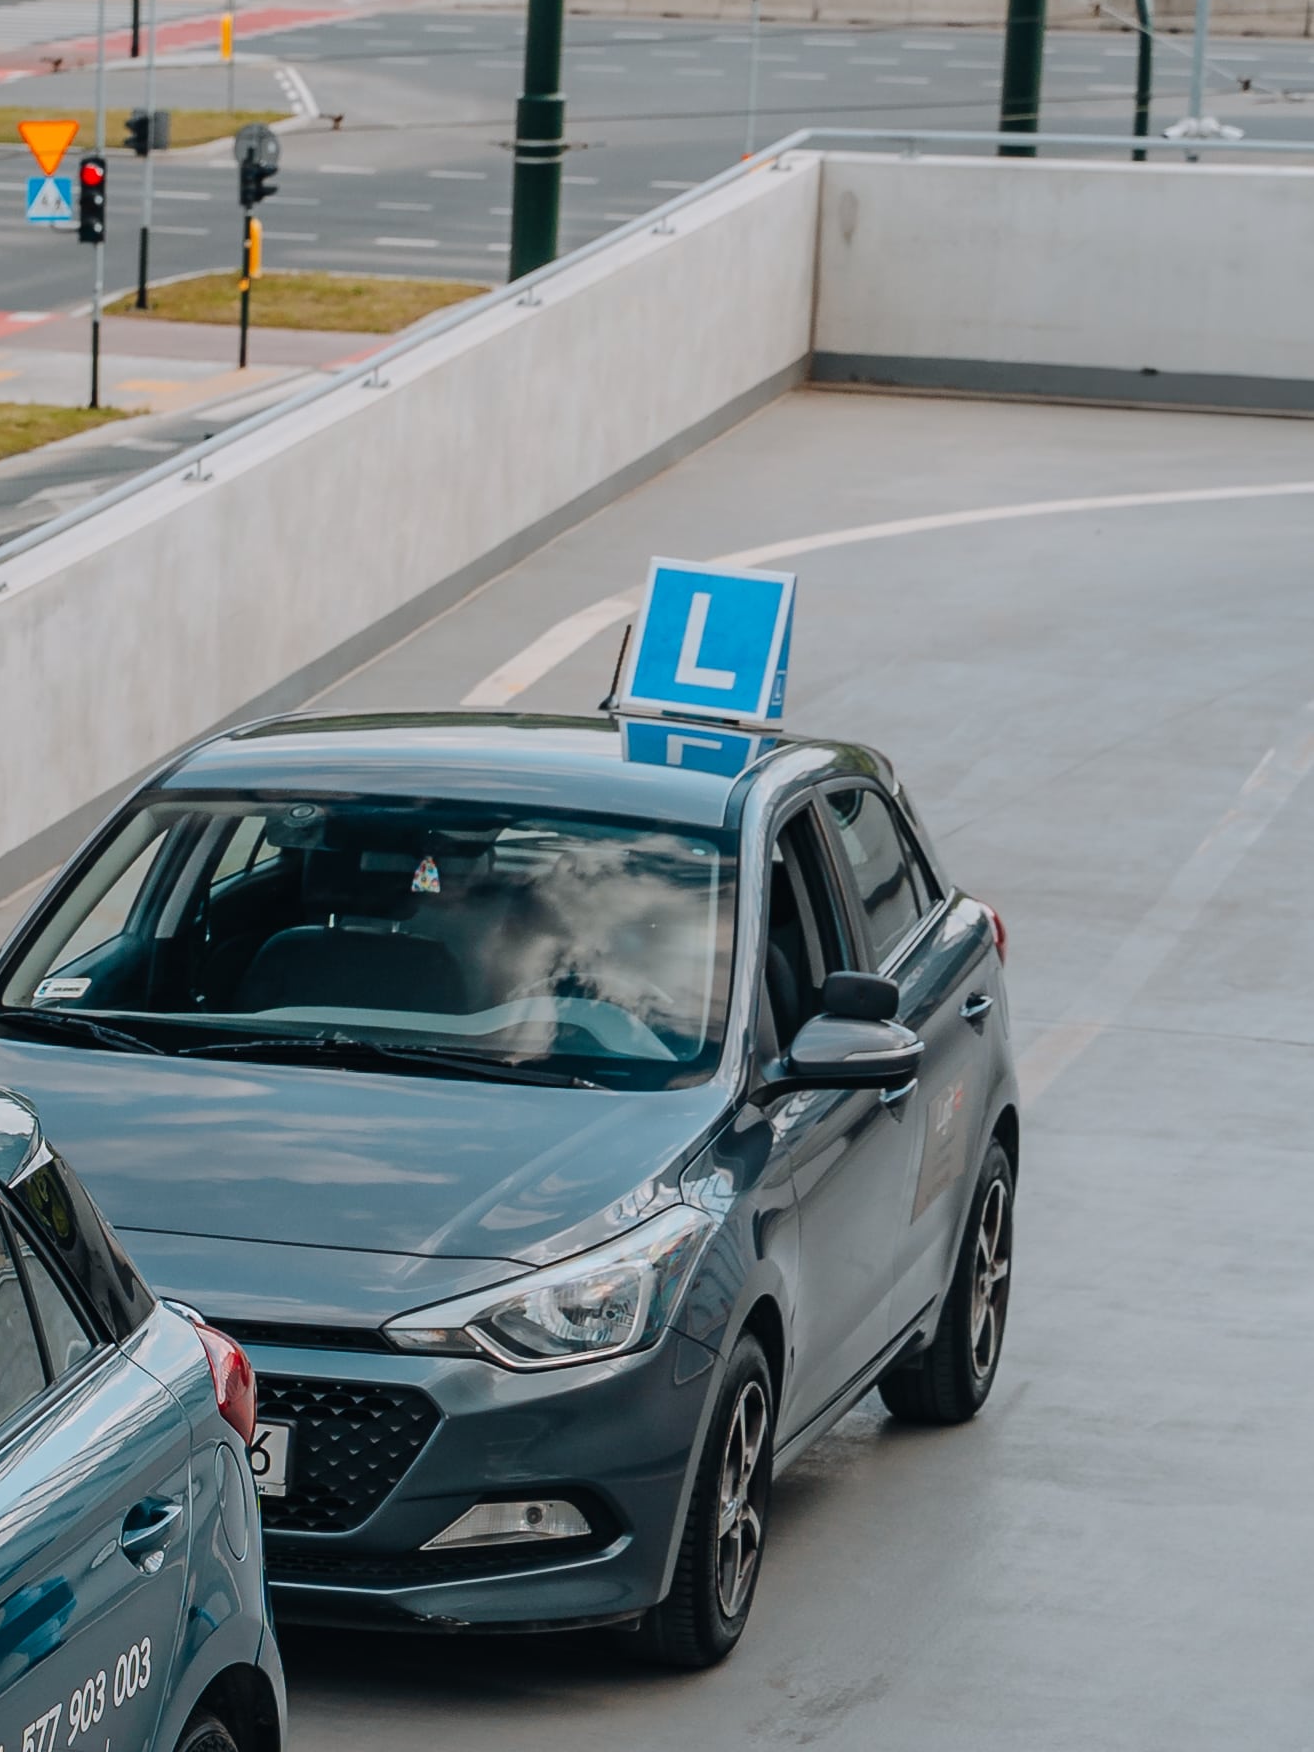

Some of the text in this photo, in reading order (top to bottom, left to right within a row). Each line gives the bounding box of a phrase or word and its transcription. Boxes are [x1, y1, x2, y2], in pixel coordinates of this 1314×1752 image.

[675, 592, 737, 690] L
[67, 1669, 106, 1746] 903
[113, 1636, 151, 1708] 003
